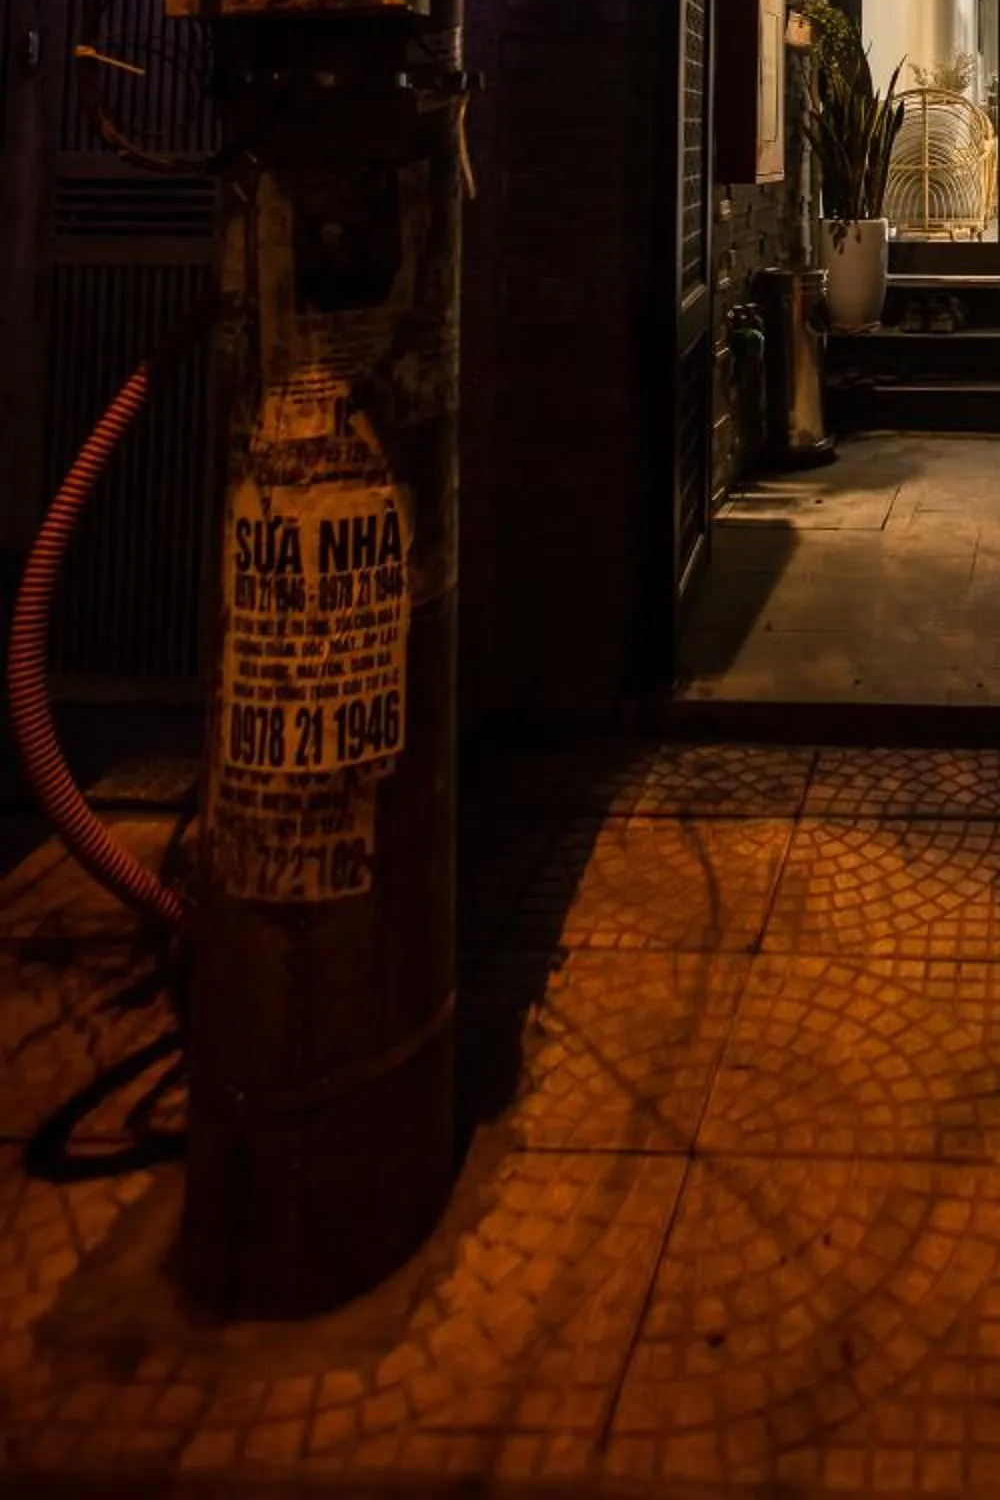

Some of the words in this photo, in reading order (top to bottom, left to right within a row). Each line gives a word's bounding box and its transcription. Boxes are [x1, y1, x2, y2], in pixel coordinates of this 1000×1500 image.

[317, 498, 403, 573] NHÀ
[231, 701, 284, 767] 0978
[295, 707, 325, 765] 21
[332, 690, 401, 760] 1946
